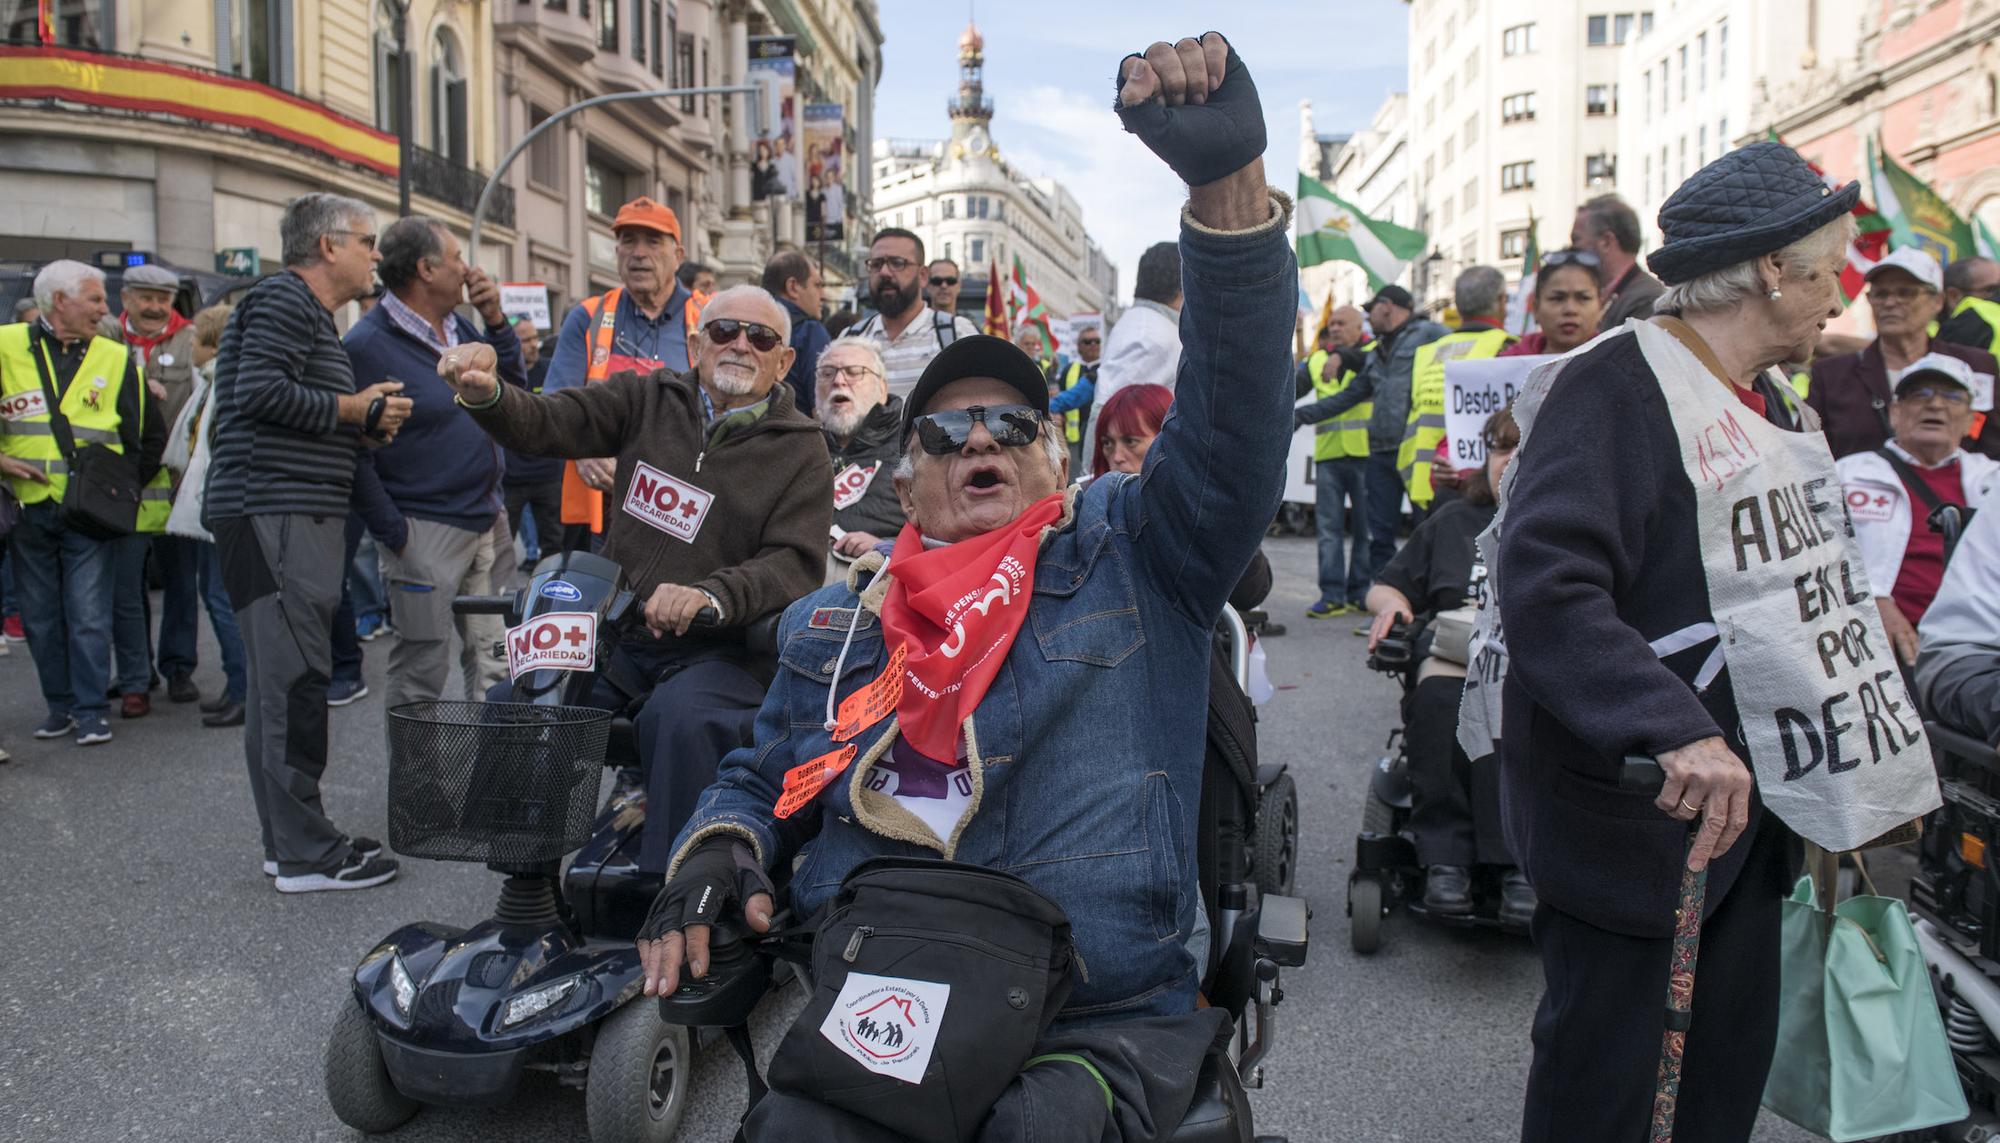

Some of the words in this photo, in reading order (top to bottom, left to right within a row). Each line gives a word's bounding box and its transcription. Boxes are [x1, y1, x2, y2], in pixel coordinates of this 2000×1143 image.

[1454, 383, 1500, 414] Desde
[1458, 432, 1484, 461] exi
[630, 497, 691, 532] PRECARIEDAD
[634, 473, 699, 519] NO+
[1848, 491, 1890, 507] O+
[1731, 477, 1855, 571] ABUE
[1841, 560, 1869, 605] L
[944, 610, 956, 626] DE
[954, 587, 984, 610] PENSI
[514, 623, 586, 659] NO+
[1817, 618, 1874, 678] POR
[1775, 670, 1920, 782] DERE
[846, 987, 884, 1008] Coordinadora
[886, 986, 907, 994] Estatal
[906, 989, 916, 998] por
[919, 1001, 930, 1024] Defensa
